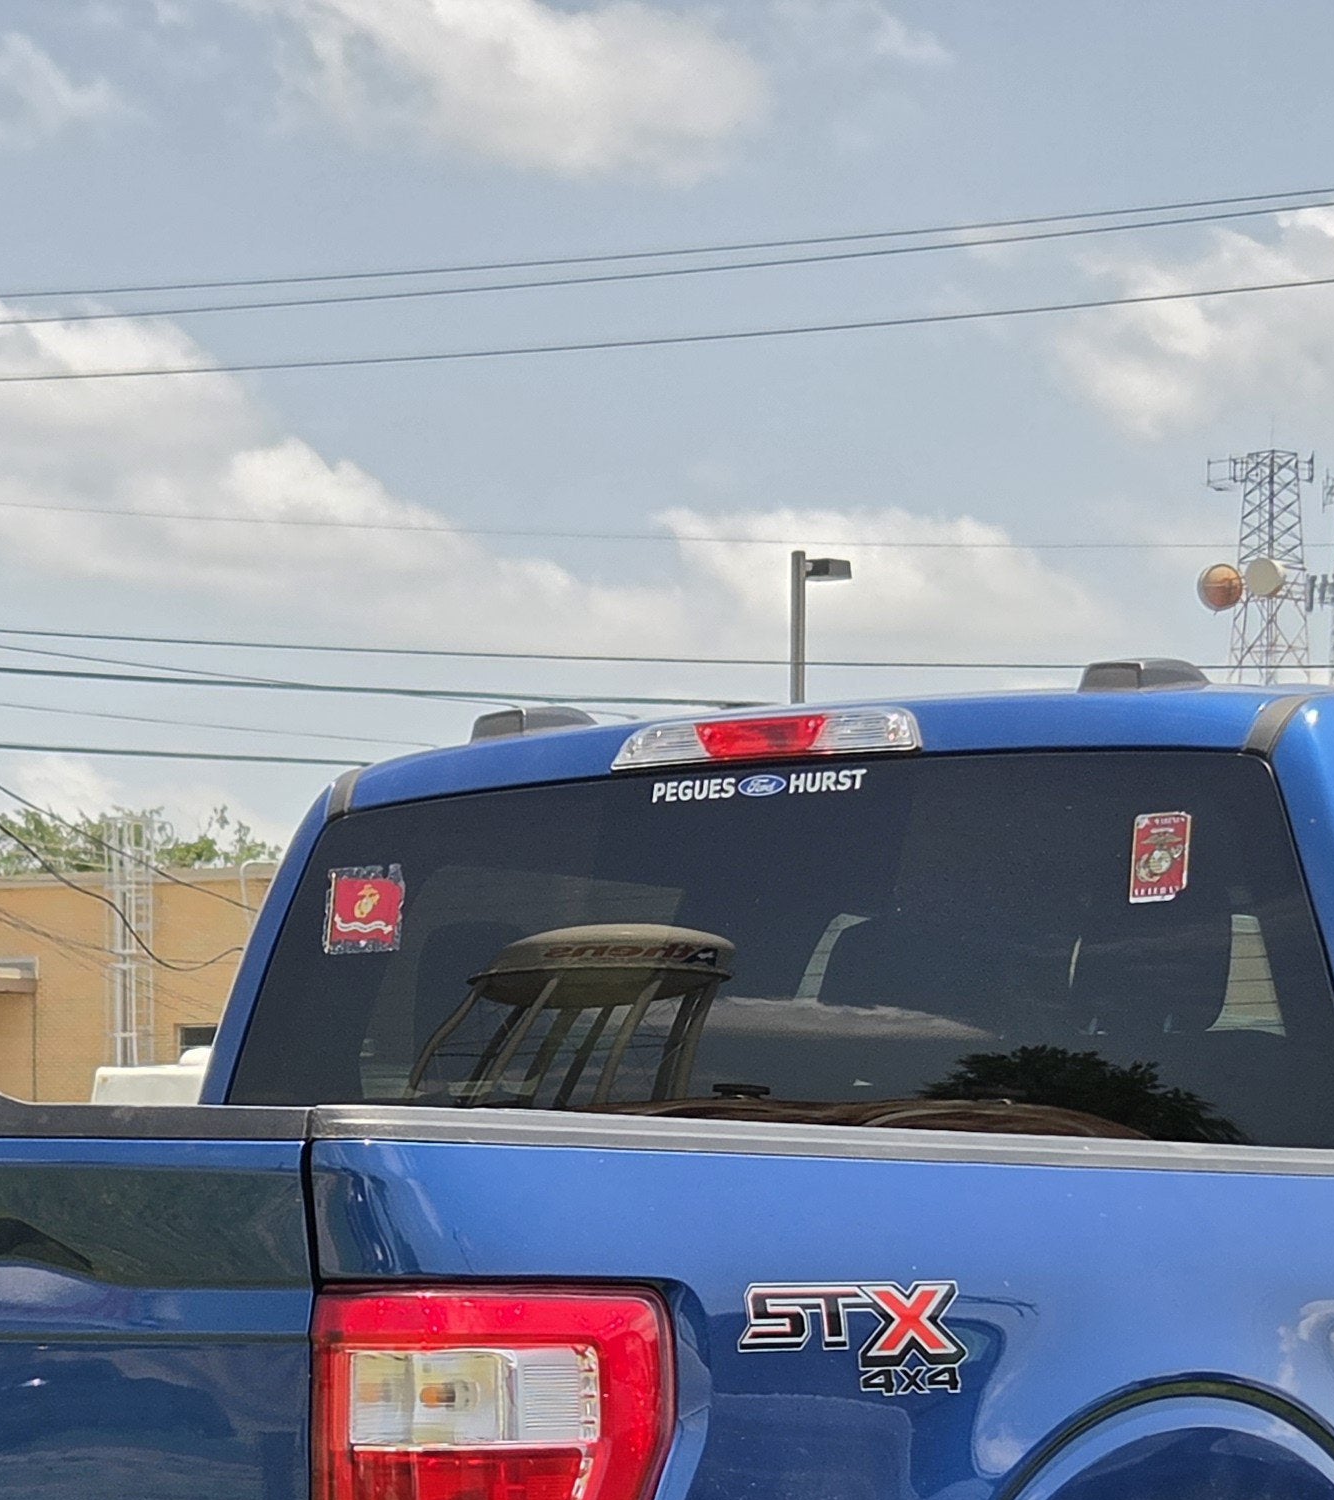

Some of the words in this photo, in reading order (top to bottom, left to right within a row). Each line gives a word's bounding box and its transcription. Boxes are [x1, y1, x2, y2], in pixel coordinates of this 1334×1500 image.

[651, 777, 736, 803] PEGUES
[788, 769, 867, 795] HURST
[737, 1280, 969, 1371] STX
